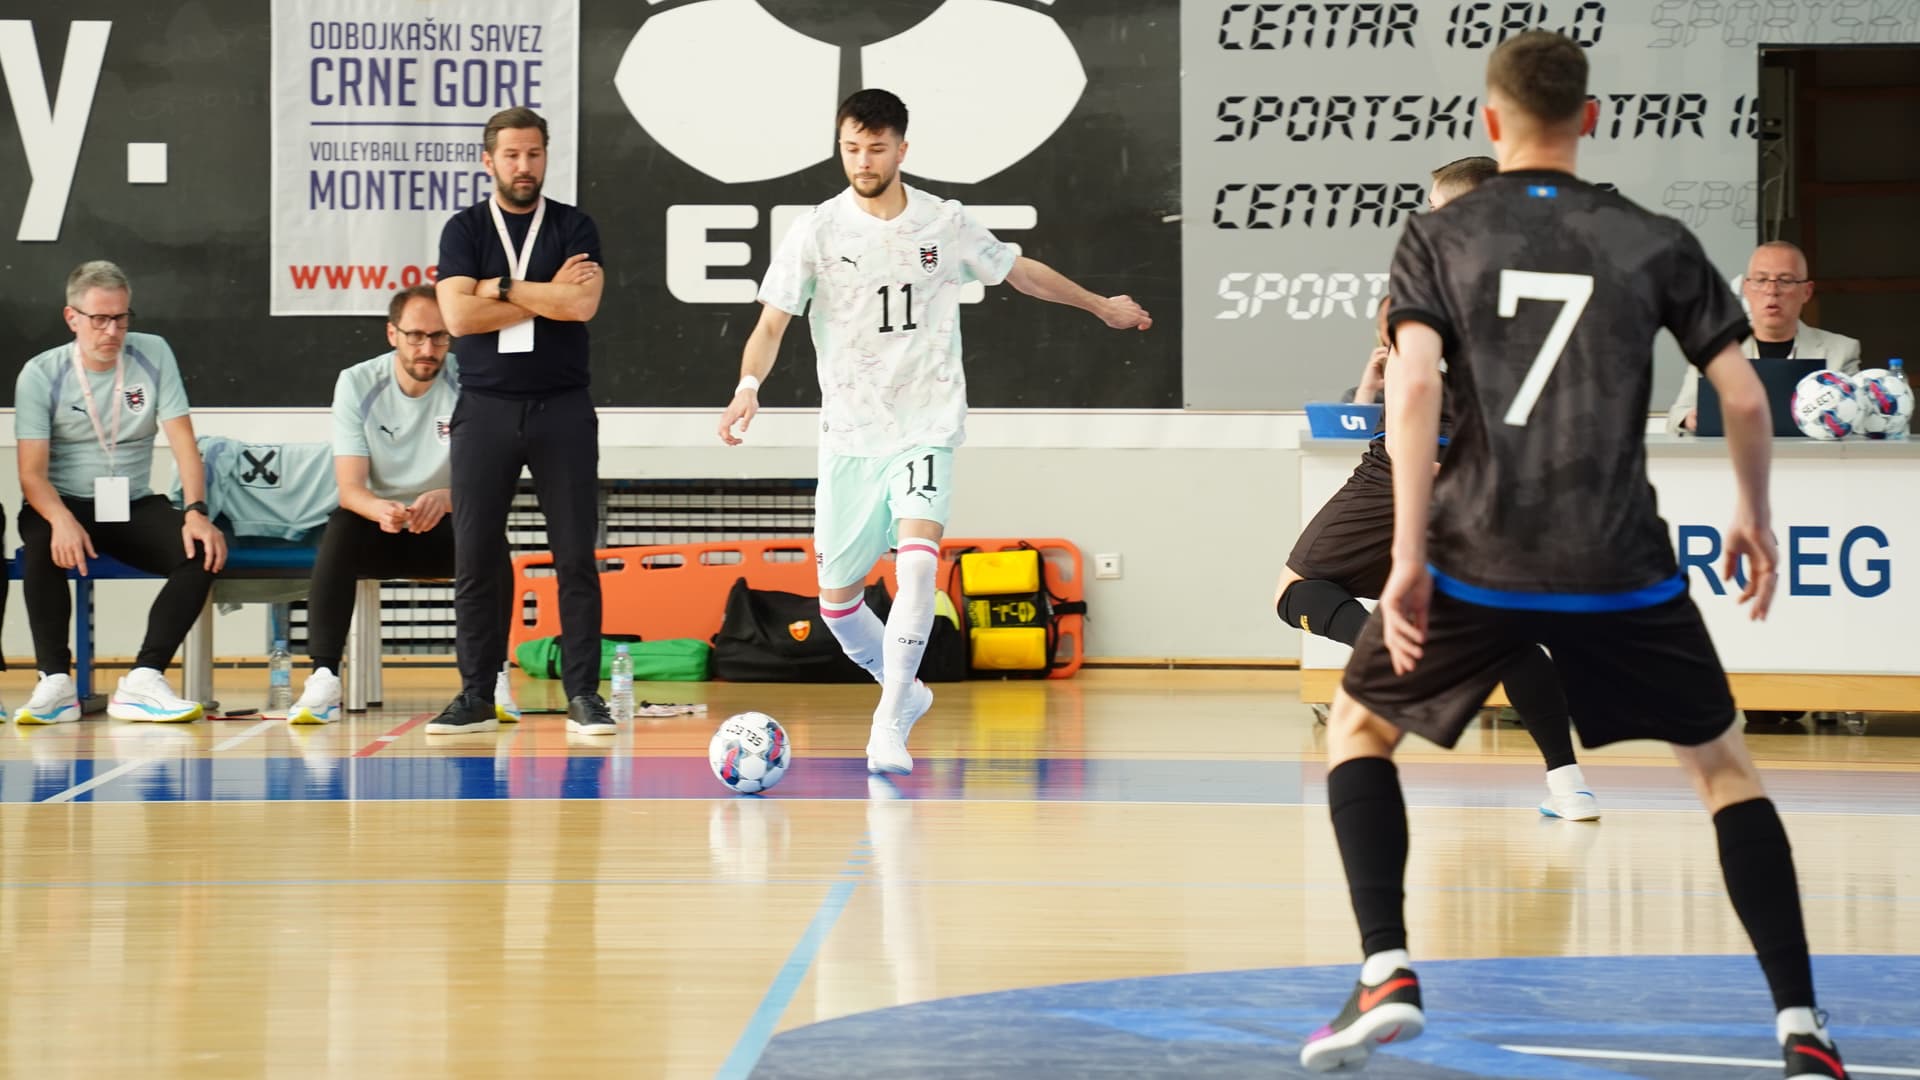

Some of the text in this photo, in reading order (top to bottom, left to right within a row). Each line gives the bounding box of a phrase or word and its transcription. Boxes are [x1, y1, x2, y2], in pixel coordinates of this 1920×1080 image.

[310, 17, 543, 53] ODBOJKAŠKI SAVEZ
[1218, 4, 1418, 50] CENTAR
[310, 57, 543, 108] CRNE GORE
[1213, 95, 1477, 142] SPORTSKI
[310, 142, 409, 162] VOLLEYBALL
[877, 284, 917, 333] 11
[1498, 269, 1594, 426] 7
[1340, 414, 1368, 431] 5
[905, 454, 937, 495] 11
